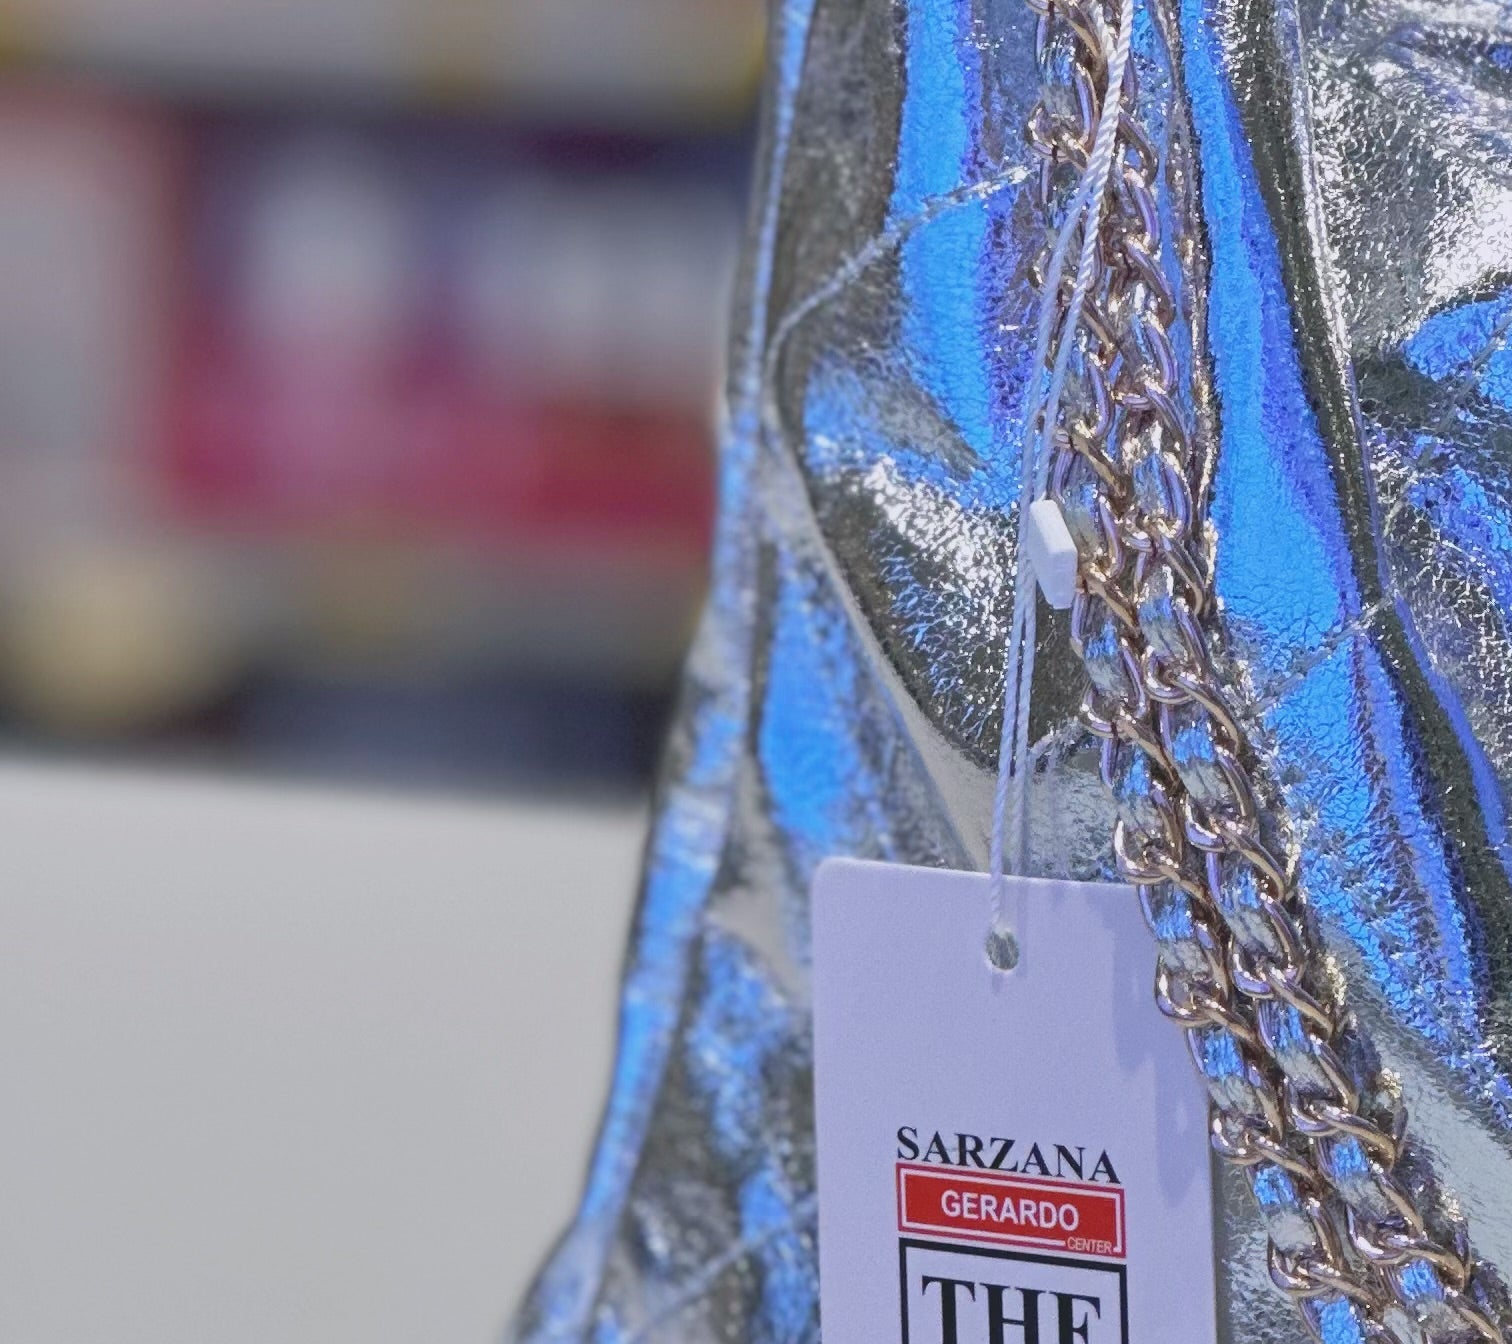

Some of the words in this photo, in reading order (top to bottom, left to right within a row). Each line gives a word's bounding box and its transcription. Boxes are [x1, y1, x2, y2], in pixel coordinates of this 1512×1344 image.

[896, 1125, 1121, 1185] SARZANA
[940, 1189, 1080, 1232] GERARDO
[1066, 1236, 1114, 1255] CENTER
